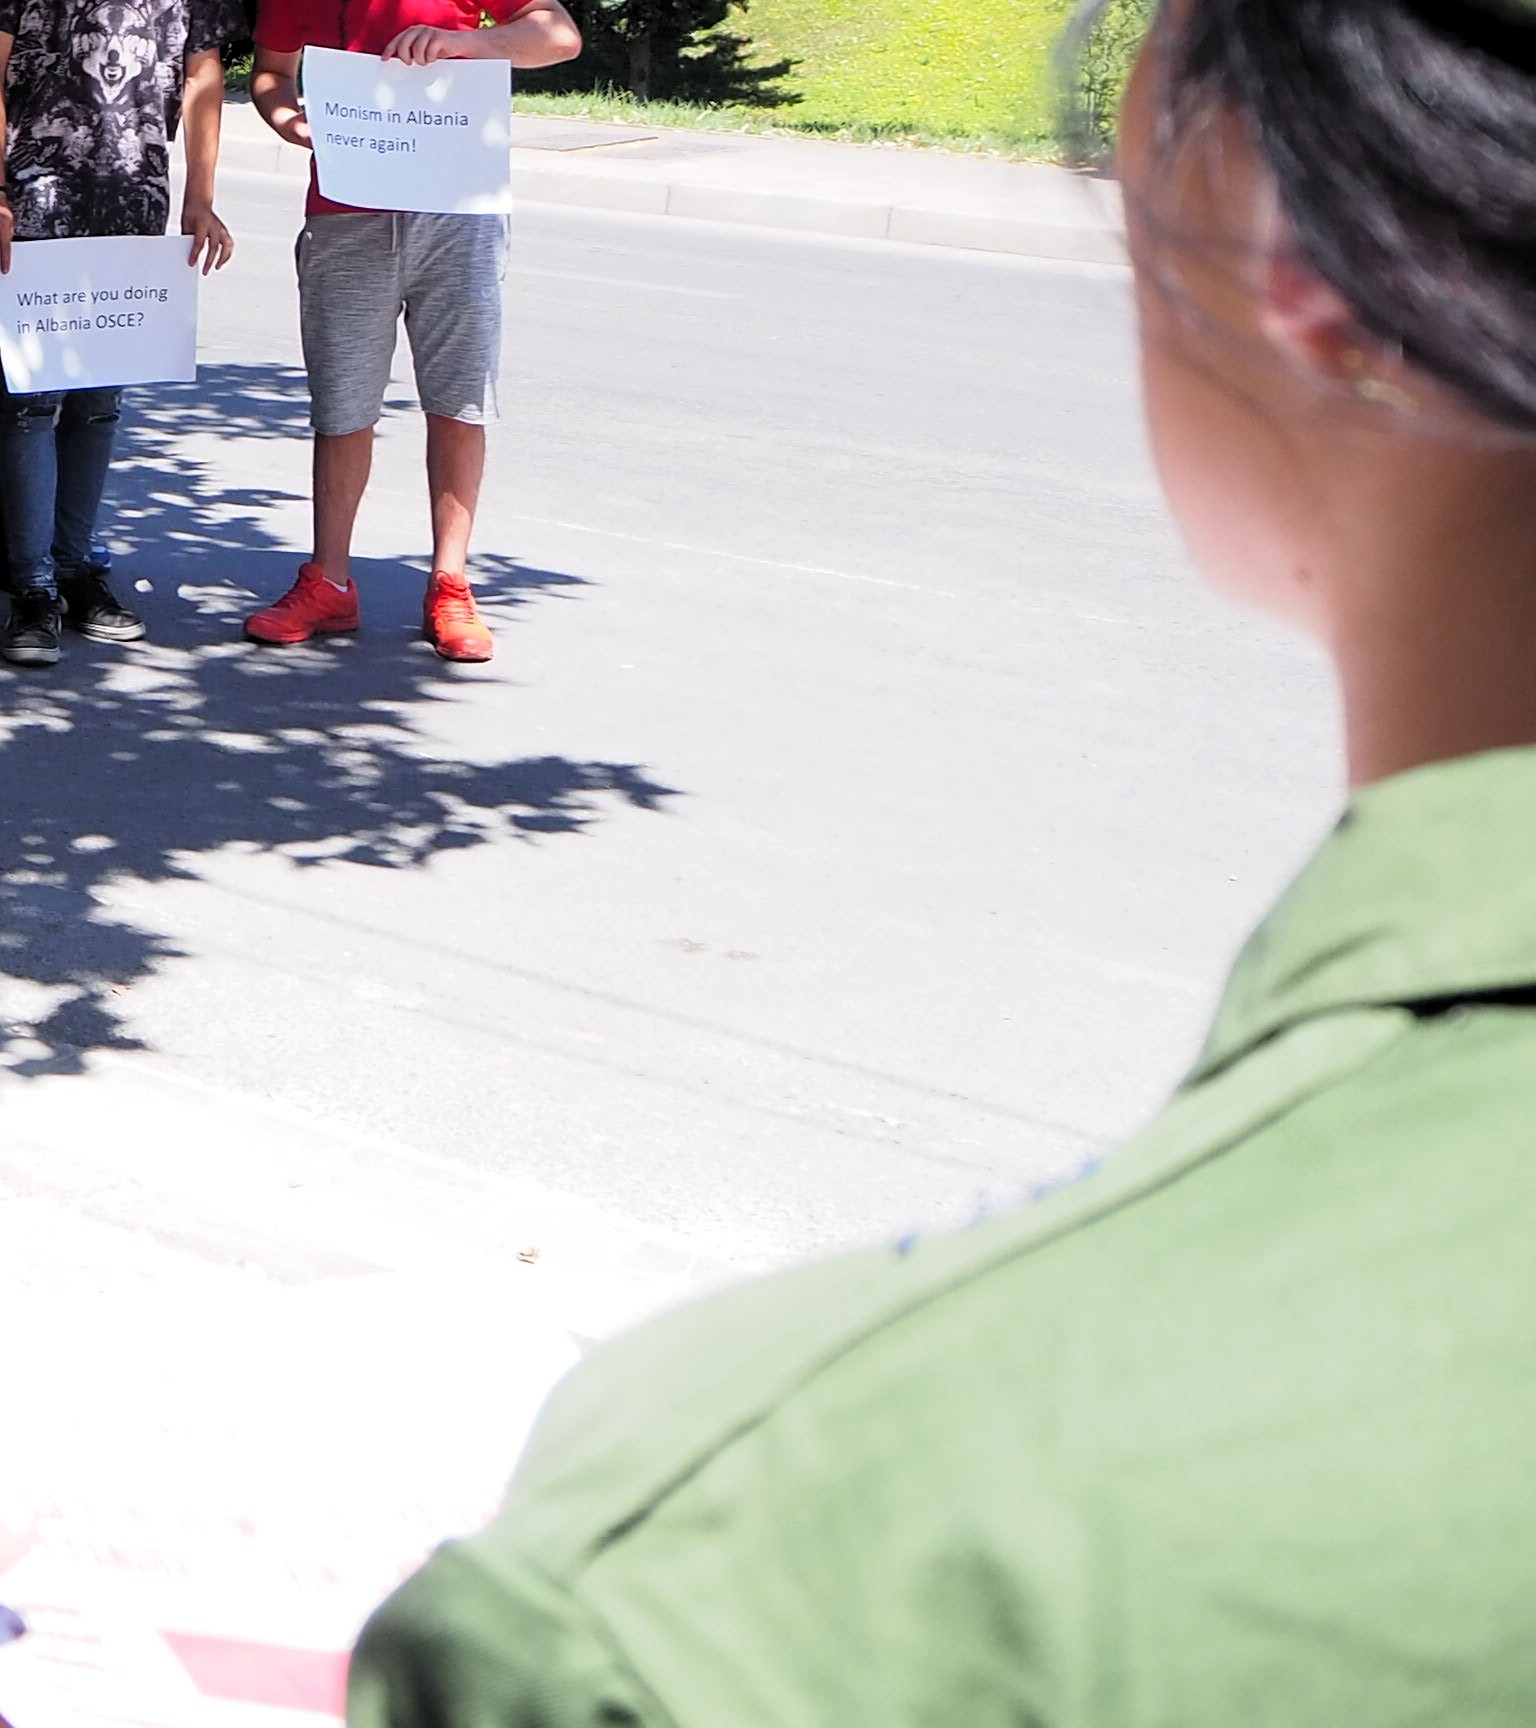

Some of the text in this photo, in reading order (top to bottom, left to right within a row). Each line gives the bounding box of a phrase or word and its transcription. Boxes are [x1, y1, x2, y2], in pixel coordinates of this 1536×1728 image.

[325, 102, 469, 126] Monism in Albania
[326, 132, 417, 154] never again!
[16, 285, 168, 307] What are you doing
[17, 312, 145, 335] in Albania OSCE?
